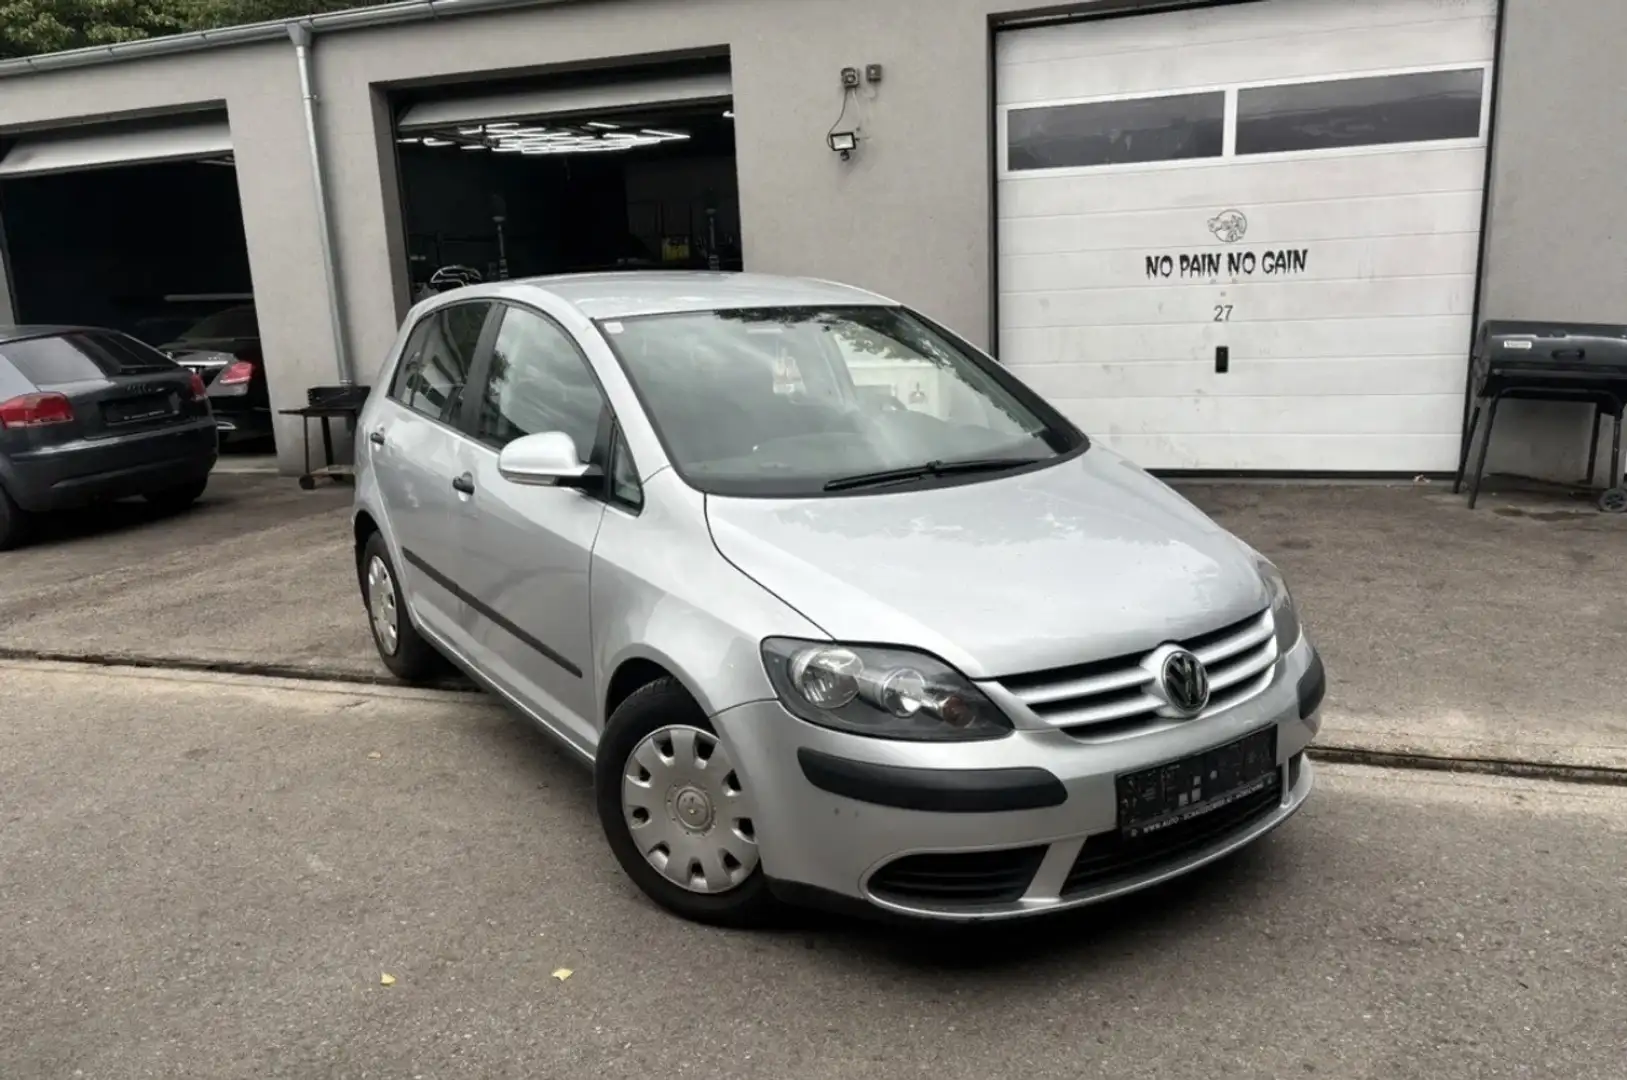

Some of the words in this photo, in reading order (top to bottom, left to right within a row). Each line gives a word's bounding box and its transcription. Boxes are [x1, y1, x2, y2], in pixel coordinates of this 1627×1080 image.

[1145, 255, 1173, 278] NO
[1179, 253, 1221, 278] PAIN
[1227, 251, 1256, 276] NO
[1261, 249, 1308, 275] GAIN
[1213, 304, 1233, 322] 27
